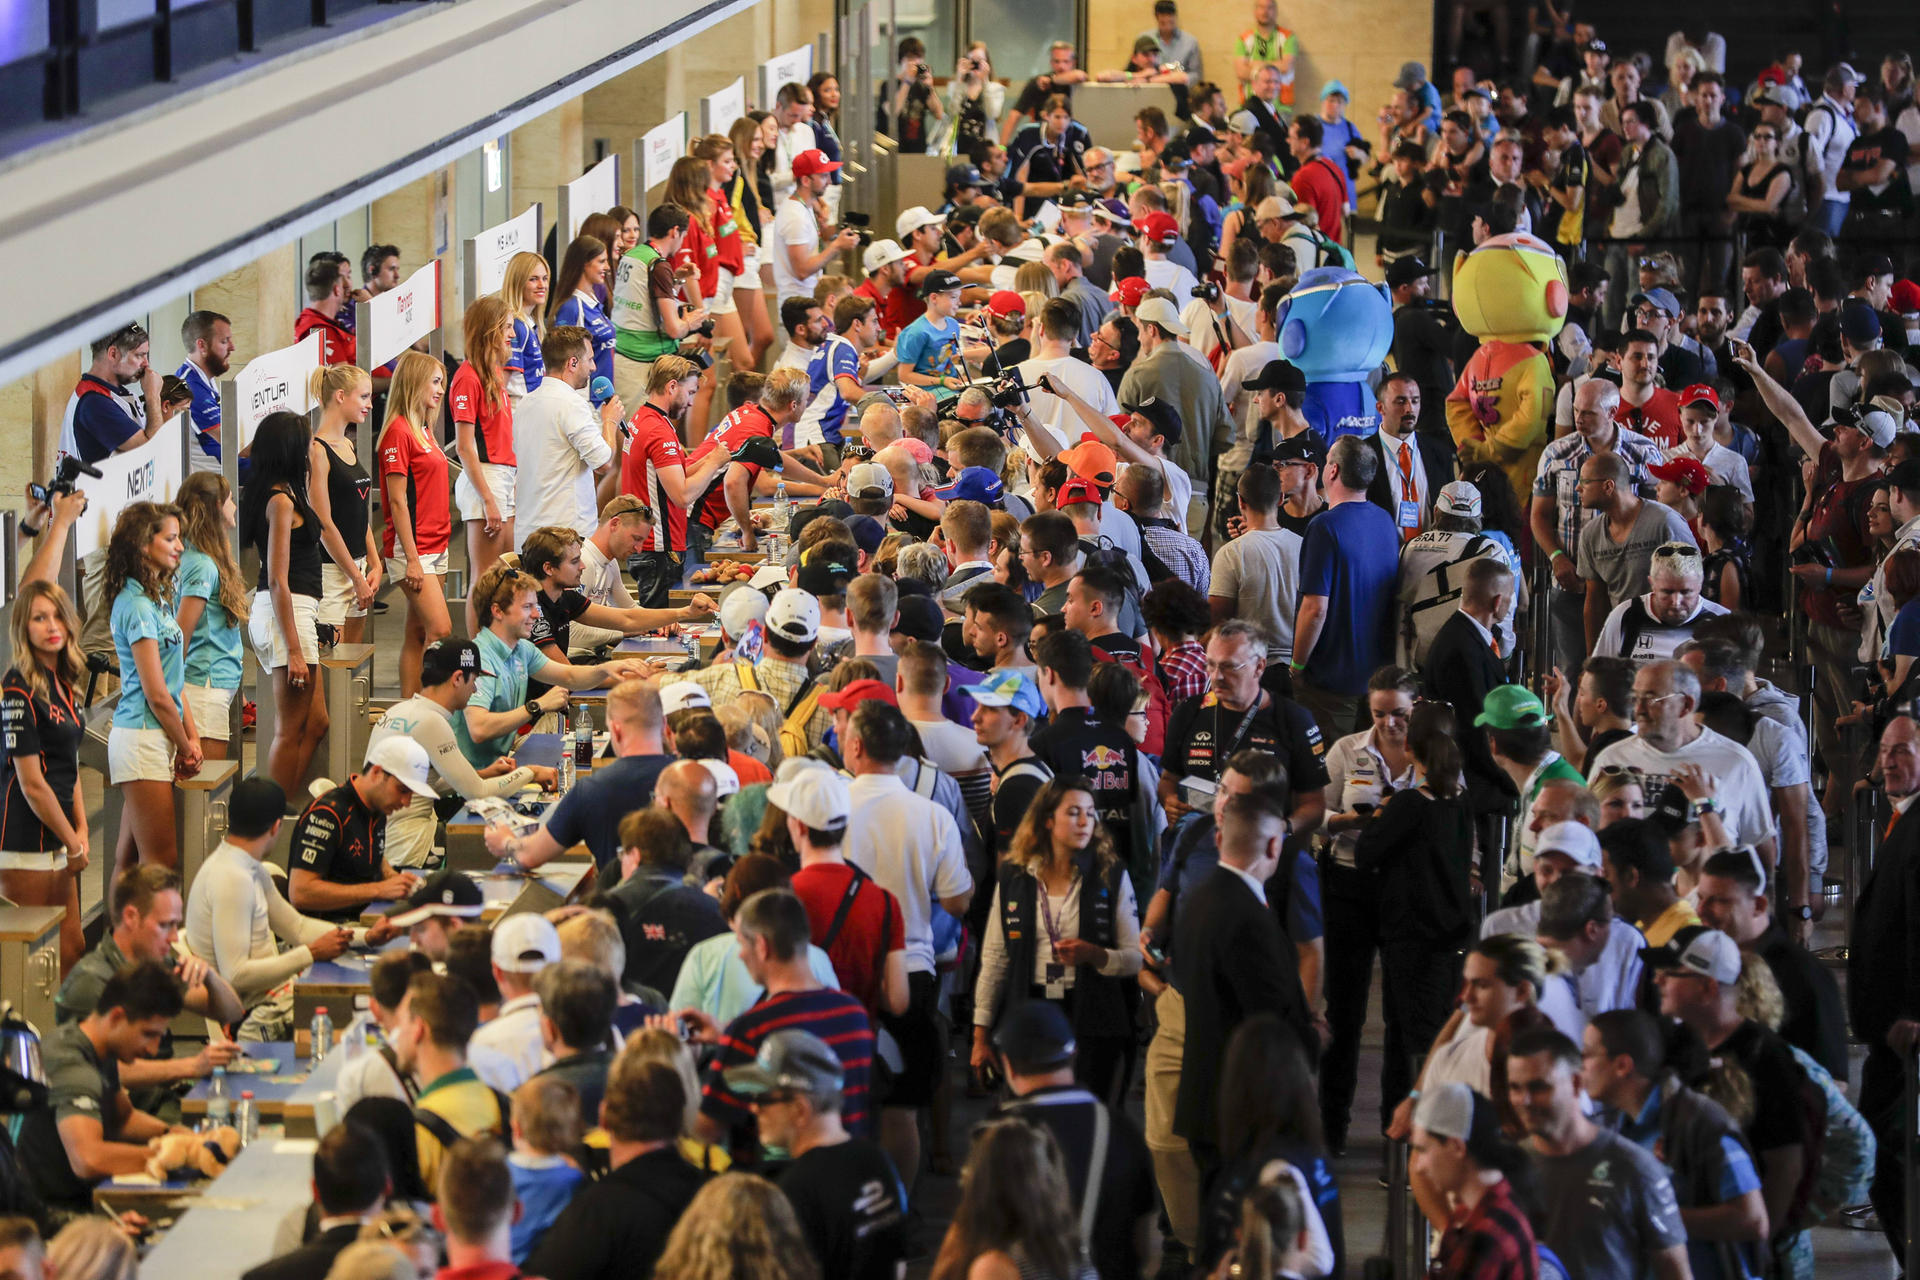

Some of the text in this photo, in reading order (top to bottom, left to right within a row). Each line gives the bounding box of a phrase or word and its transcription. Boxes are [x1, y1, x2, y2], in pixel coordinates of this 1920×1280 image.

[663, 441, 677, 449] AVIS
[385, 447, 398, 455] AVIS
[1438, 532, 1453, 543] 77
